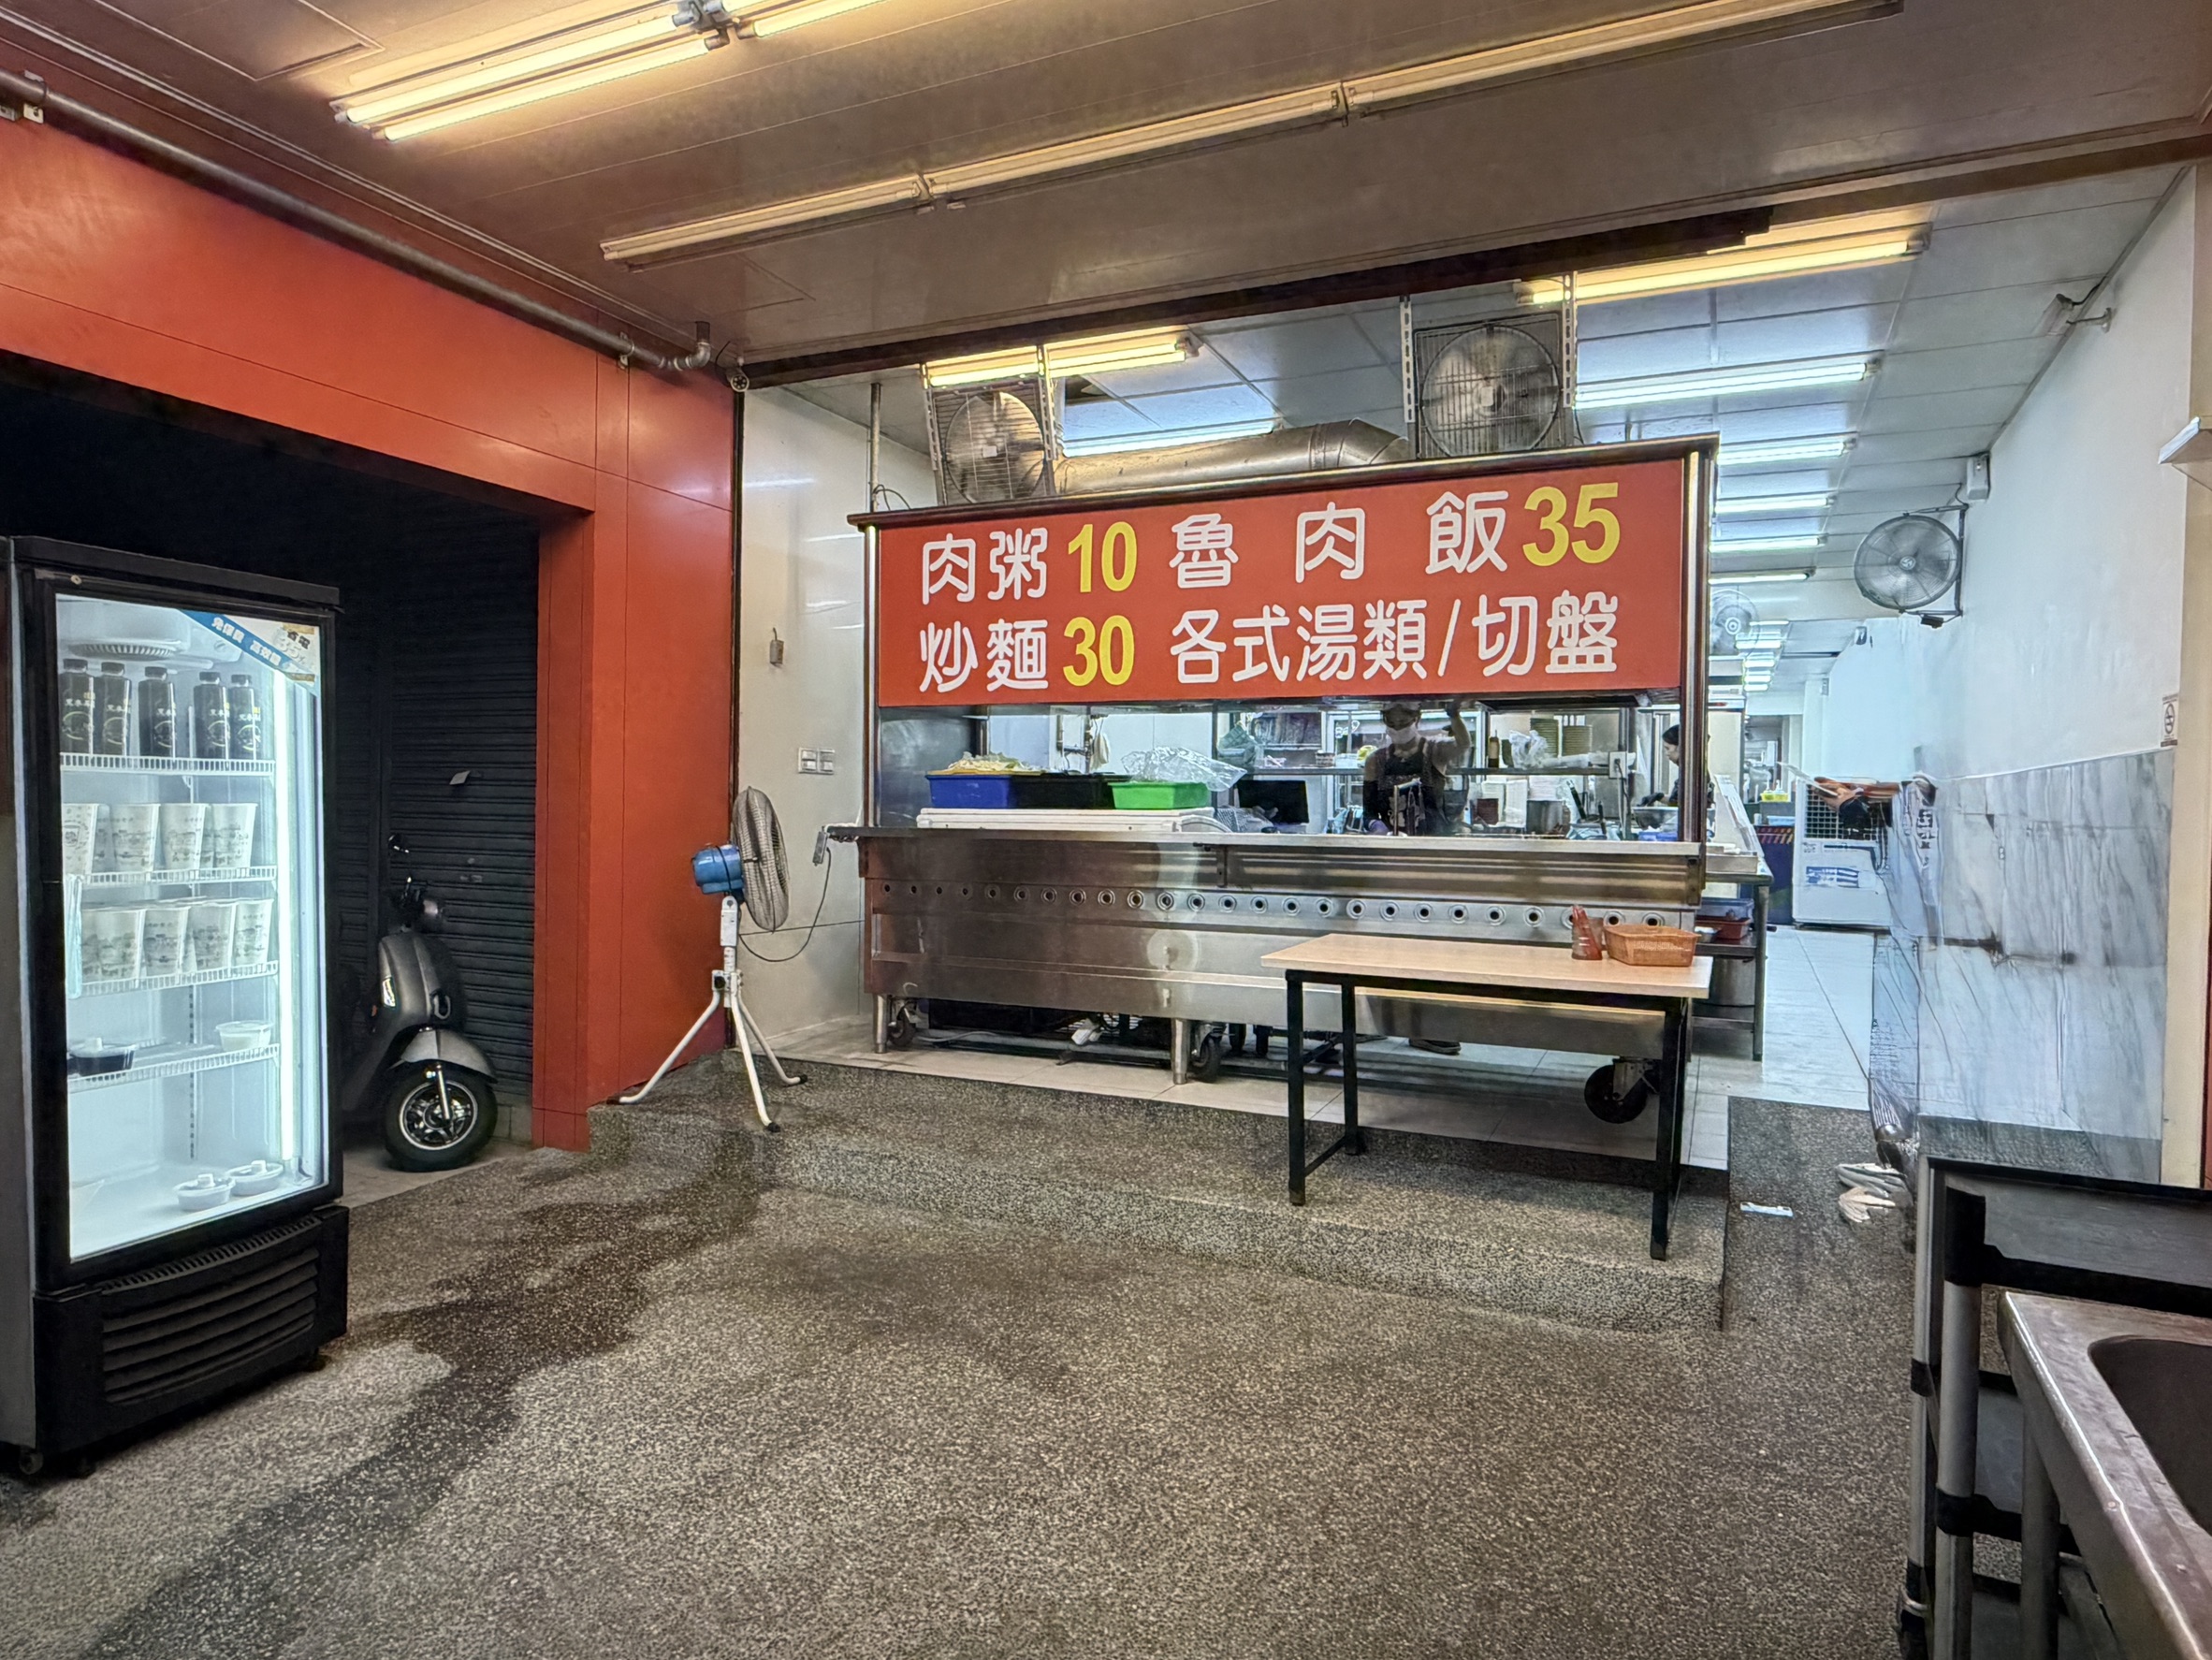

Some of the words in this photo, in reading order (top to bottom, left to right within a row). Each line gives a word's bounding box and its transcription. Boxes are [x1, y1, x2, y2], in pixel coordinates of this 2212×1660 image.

[923, 528, 1048, 605] 肉粥
[1068, 521, 1138, 593] 10
[1169, 490, 1509, 590] 魯肉飯
[1522, 482, 1621, 567] 35
[920, 619, 1049, 693] 炒麵
[1062, 614, 1135, 687] 30
[1170, 590, 1619, 684] 各式湯類/切盤
